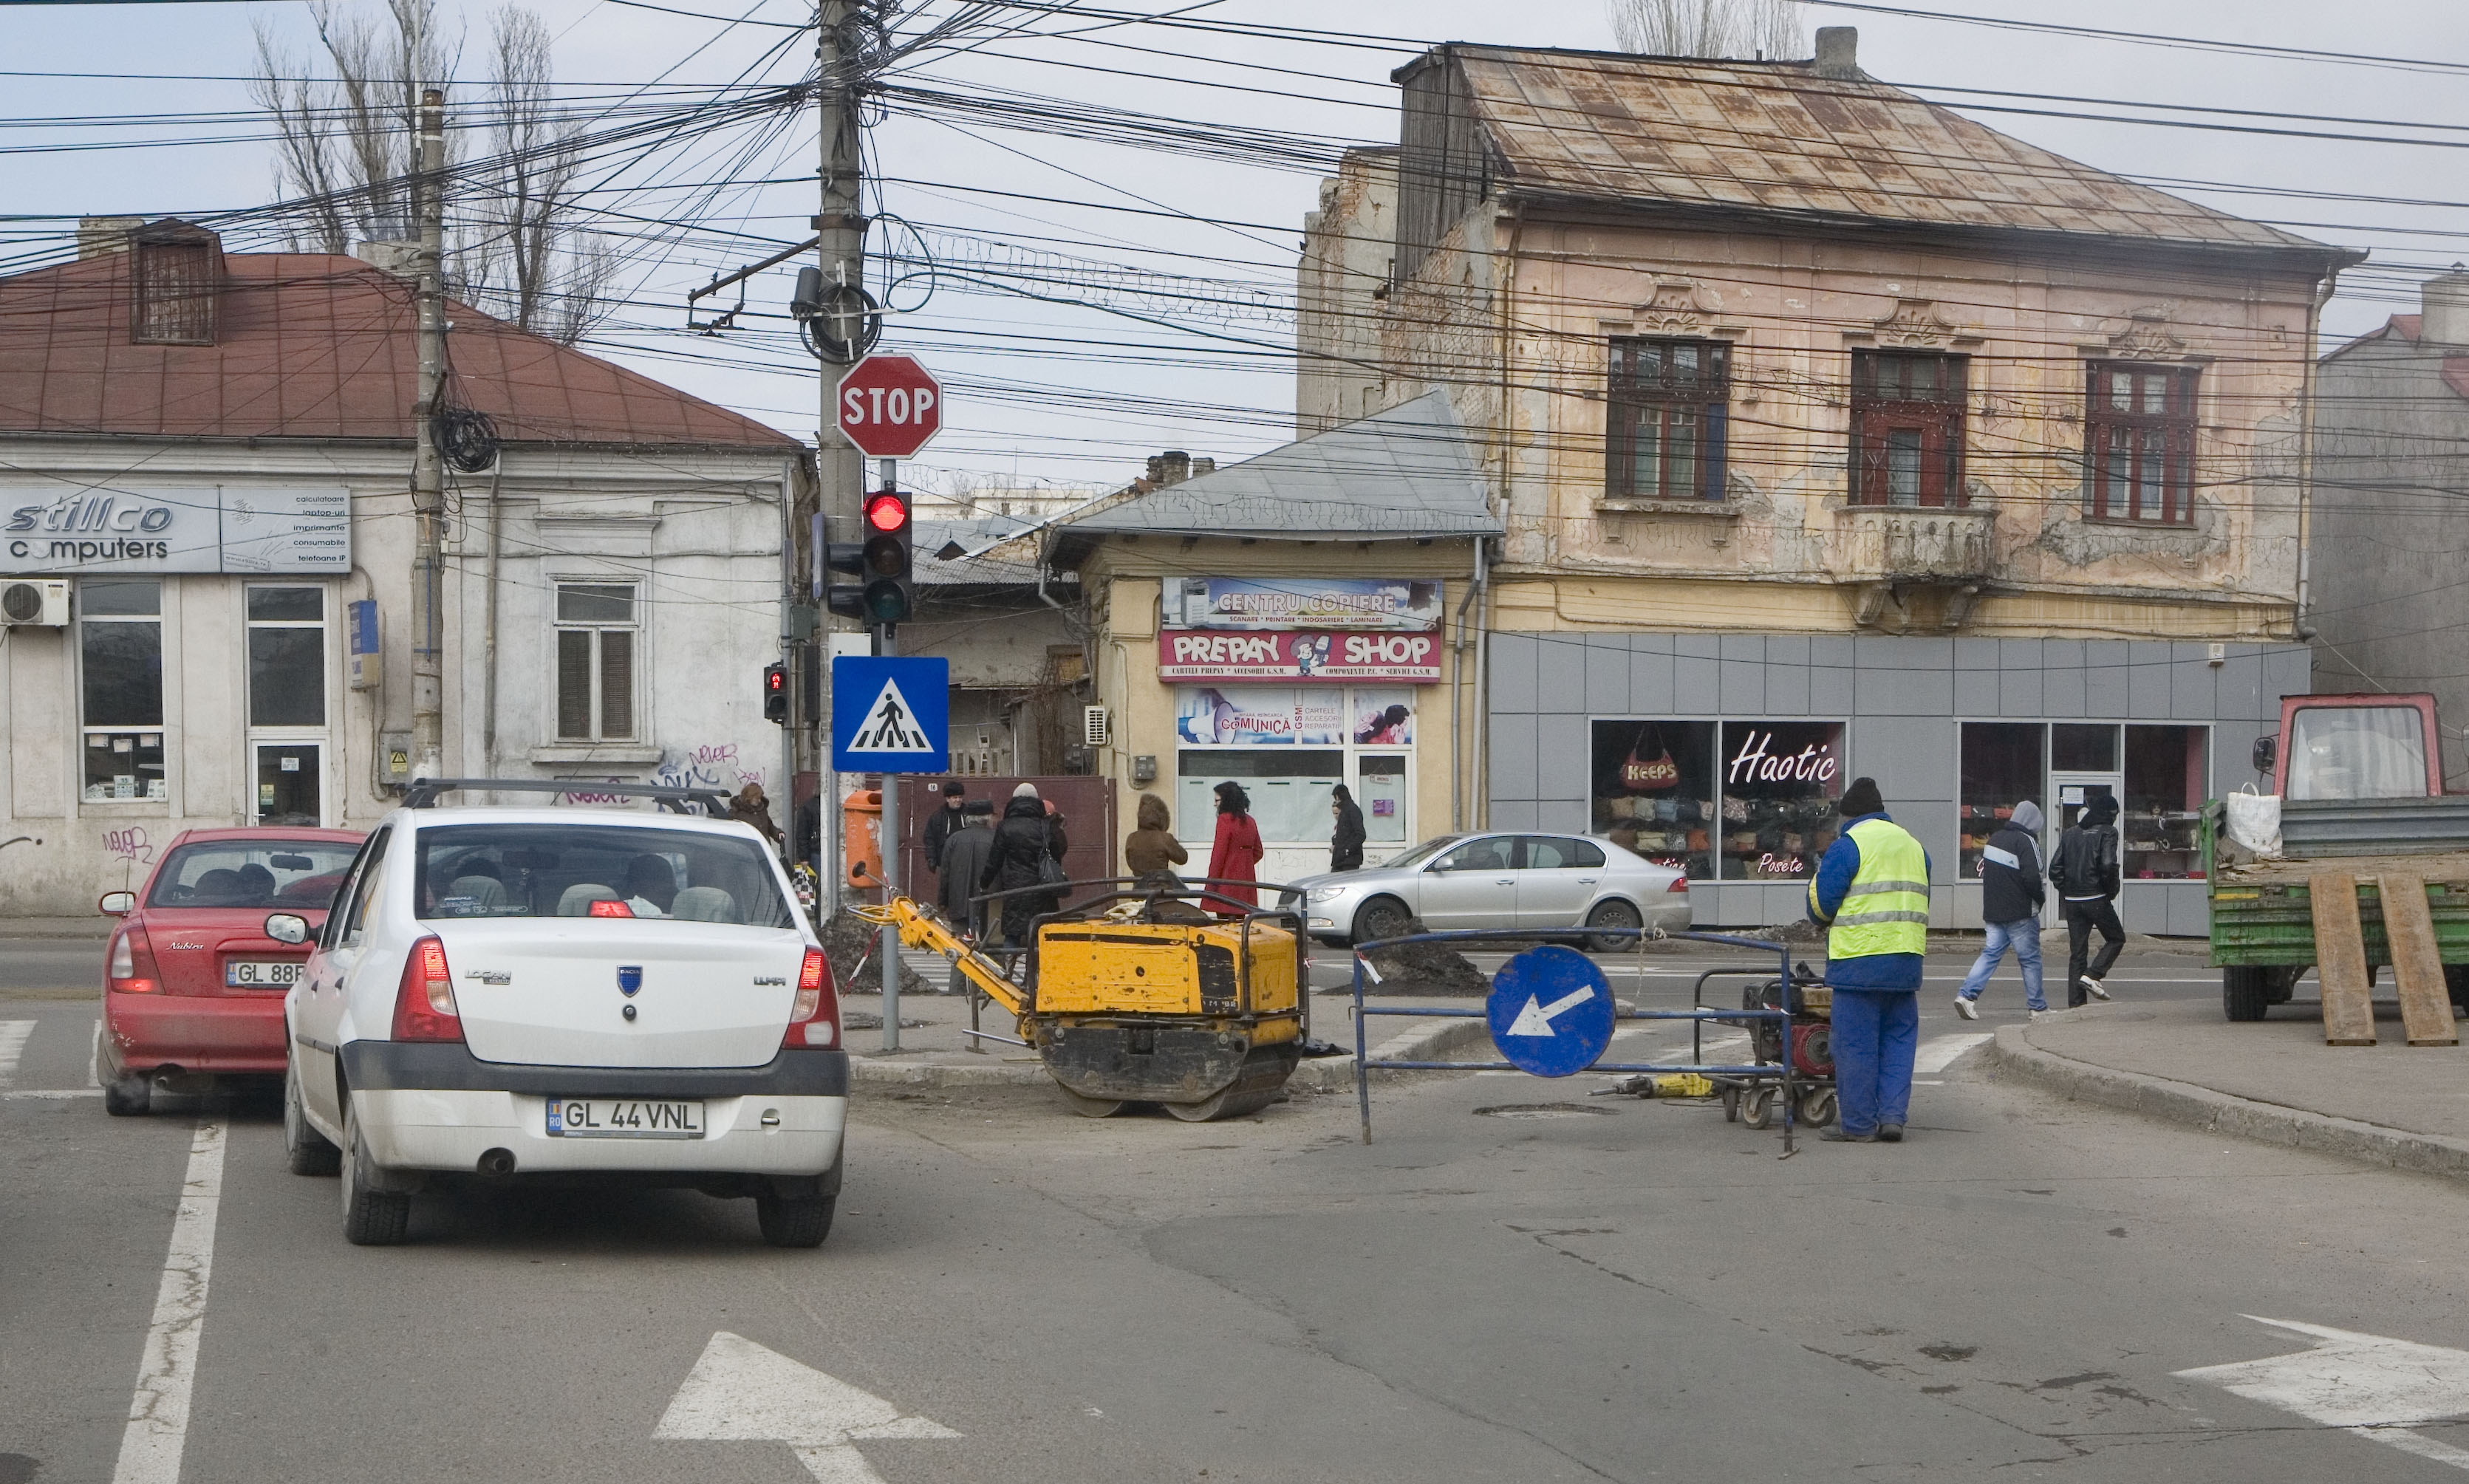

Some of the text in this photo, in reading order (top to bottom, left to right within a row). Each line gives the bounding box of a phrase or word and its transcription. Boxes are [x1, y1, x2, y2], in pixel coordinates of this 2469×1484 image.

[844, 387, 935, 425] STOP
[5, 496, 173, 532] stillco
[293, 524, 345, 533] imprimante
[10, 537, 168, 562] computers
[1218, 592, 1396, 613] CENTRU COPIERE
[1172, 634, 1432, 665] PREPAY SHOP
[1294, 707, 1303, 729] GSM
[1729, 731, 1836, 784] Haotic
[1758, 852, 1804, 875] Posete
[165, 941, 204, 951] Nubira
[239, 964, 264, 982] GL
[465, 968, 511, 979] LOGAN
[549, 1116, 561, 1127] RO
[566, 1103, 697, 1129] GL 44 VNL
